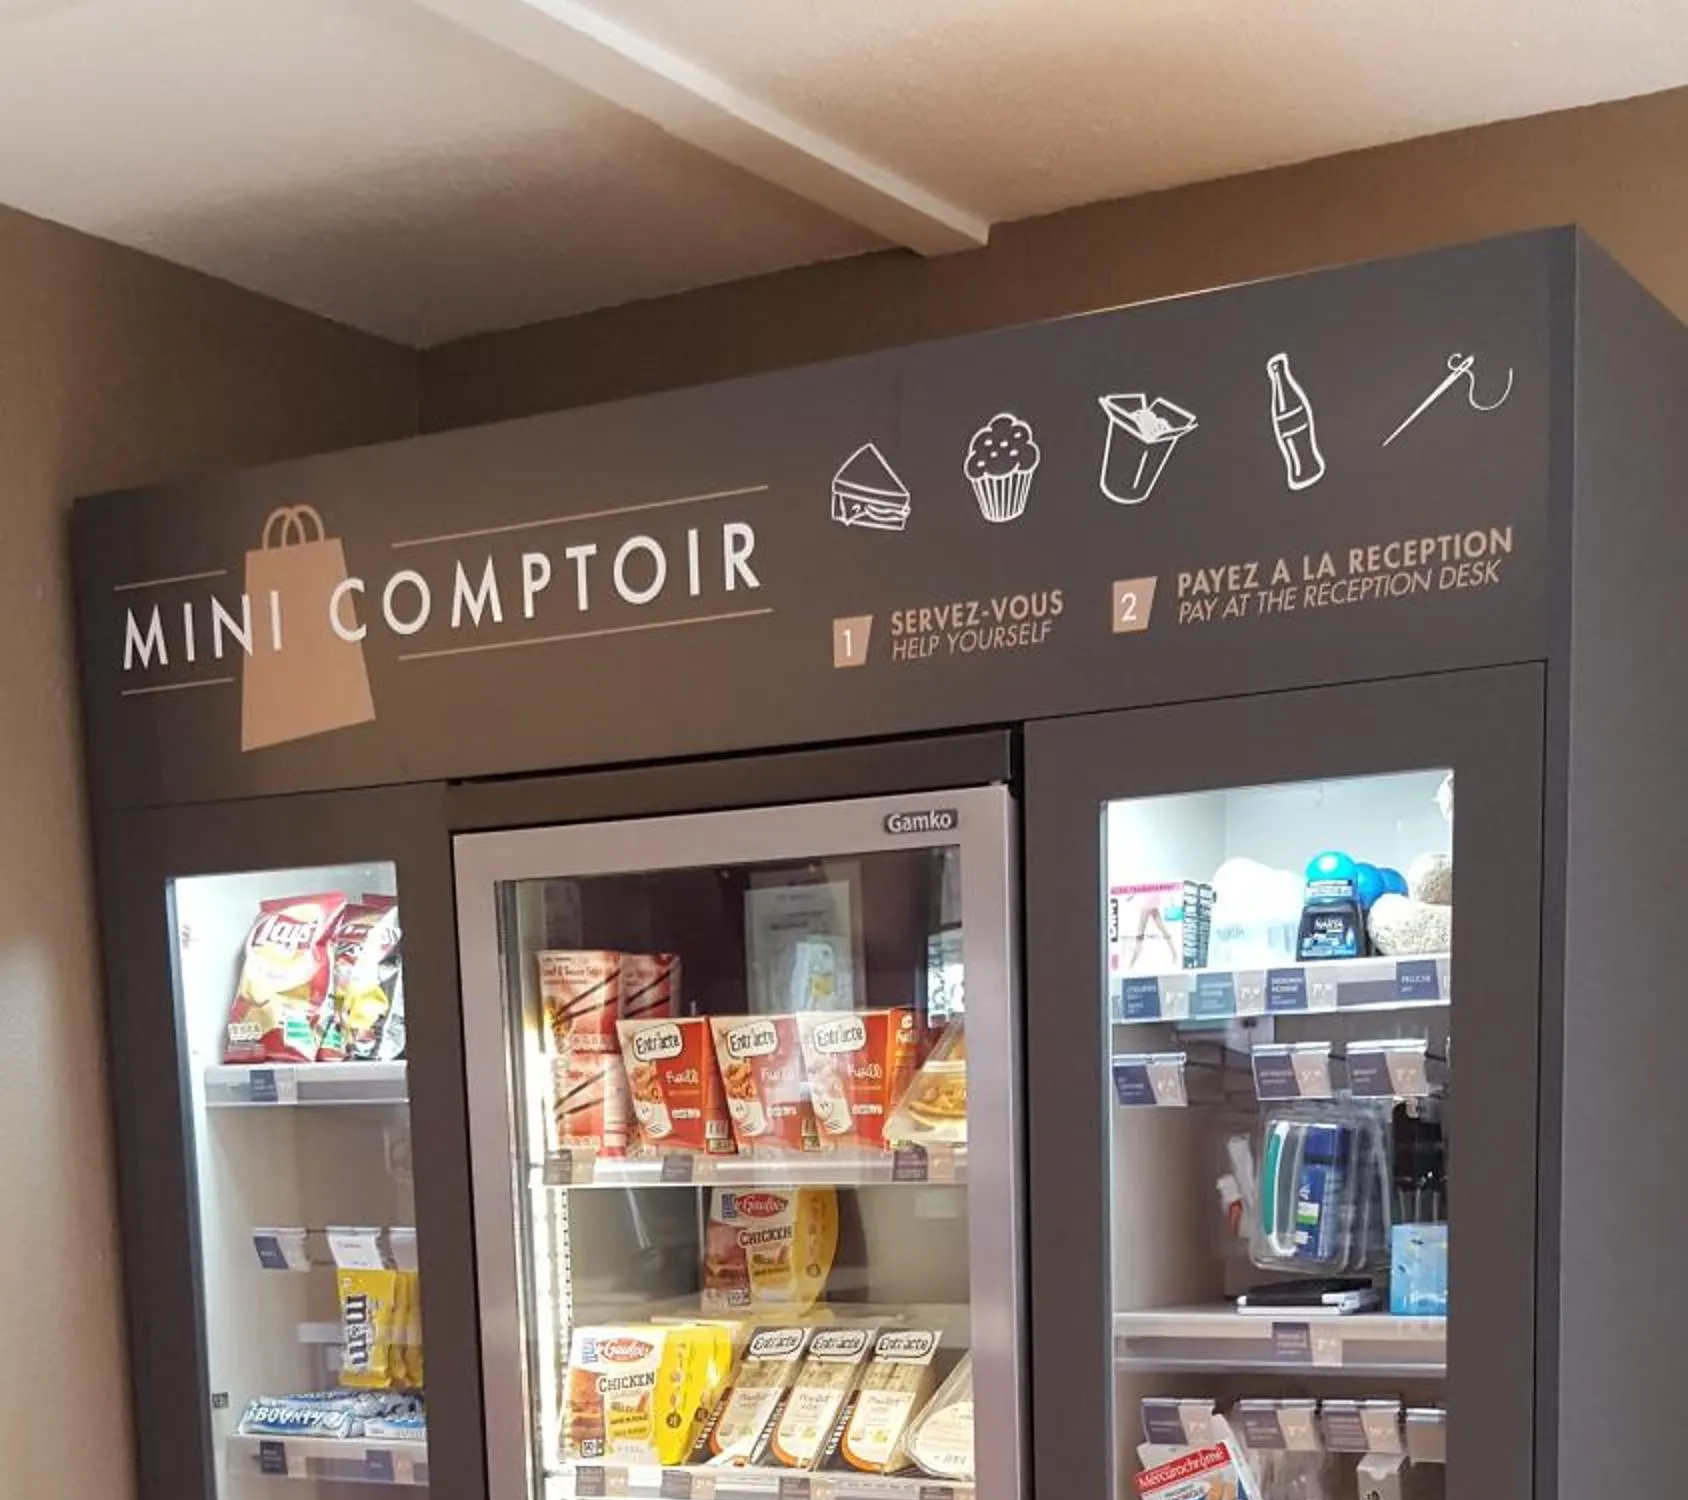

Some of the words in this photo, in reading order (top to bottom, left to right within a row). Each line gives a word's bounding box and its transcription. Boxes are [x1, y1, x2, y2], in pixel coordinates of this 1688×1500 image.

[1177, 560, 1260, 598] PAYEZ
[1271, 558, 1292, 586] A
[1303, 552, 1337, 581] LA
[1349, 526, 1514, 575] RECEPTION
[123, 589, 282, 670] MINI
[329, 522, 761, 642] COMPTOIR
[1120, 592, 1138, 624] 2
[1178, 597, 1216, 625] PAY
[1222, 593, 1249, 619] AT
[1256, 586, 1297, 615] THE
[1304, 569, 1433, 609] RECEPTION
[1440, 559, 1502, 590] DESK
[891, 589, 1065, 637] SERVEZ-VOUS
[841, 628, 852, 658] 1
[892, 633, 940, 661] HELP
[947, 620, 1052, 654] YOURSELF
[887, 809, 952, 833] Gamko
[598, 1371, 656, 1393] CHICKEN
[254, 1406, 322, 1426] BOUNTY
